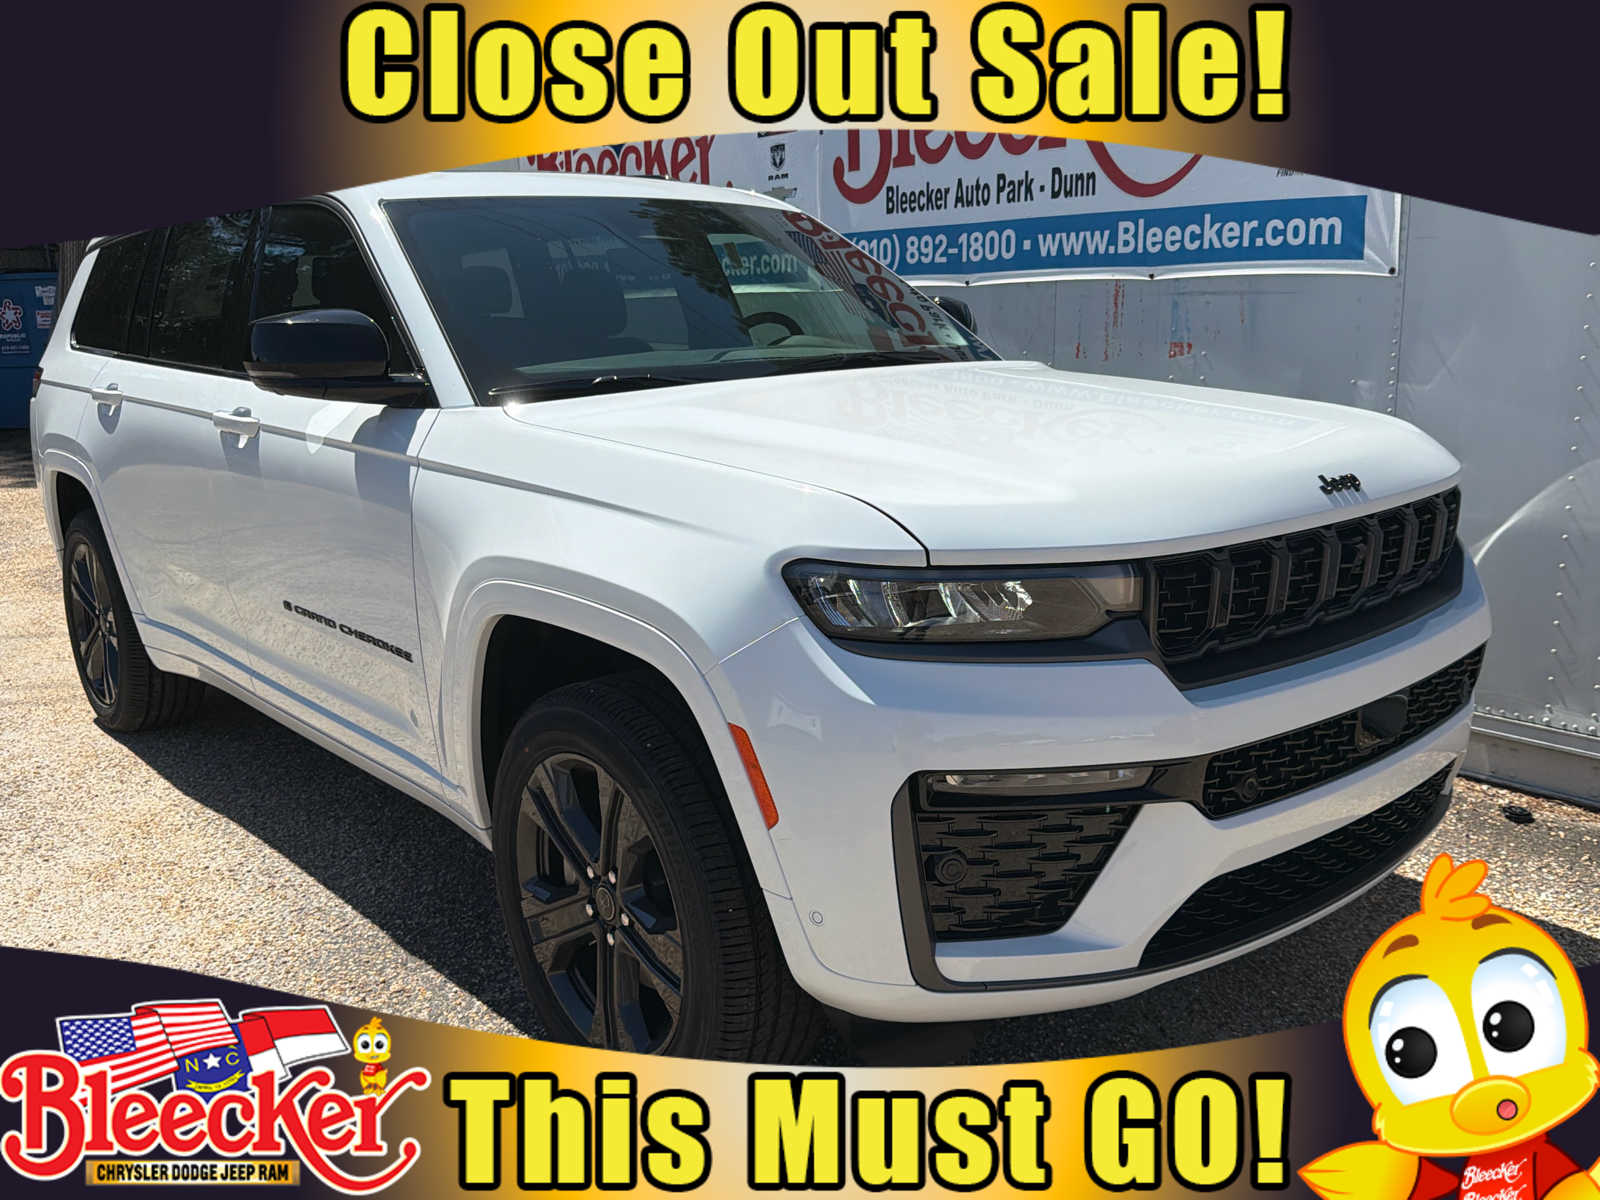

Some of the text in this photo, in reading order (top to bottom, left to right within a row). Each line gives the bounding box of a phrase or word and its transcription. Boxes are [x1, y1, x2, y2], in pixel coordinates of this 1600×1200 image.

[768, 173, 789, 181] RAM
[885, 181, 950, 214] Bleecker
[954, 177, 991, 209] Auto
[995, 170, 1035, 204] Park
[1050, 166, 1097, 199] Dunn
[906, 228, 1016, 264] 892-1800
[1037, 214, 1343, 257] www.Bleecker.com
[1318, 473, 1361, 495] Jeep
[294, 605, 414, 663] GRAND CHEROKEE
